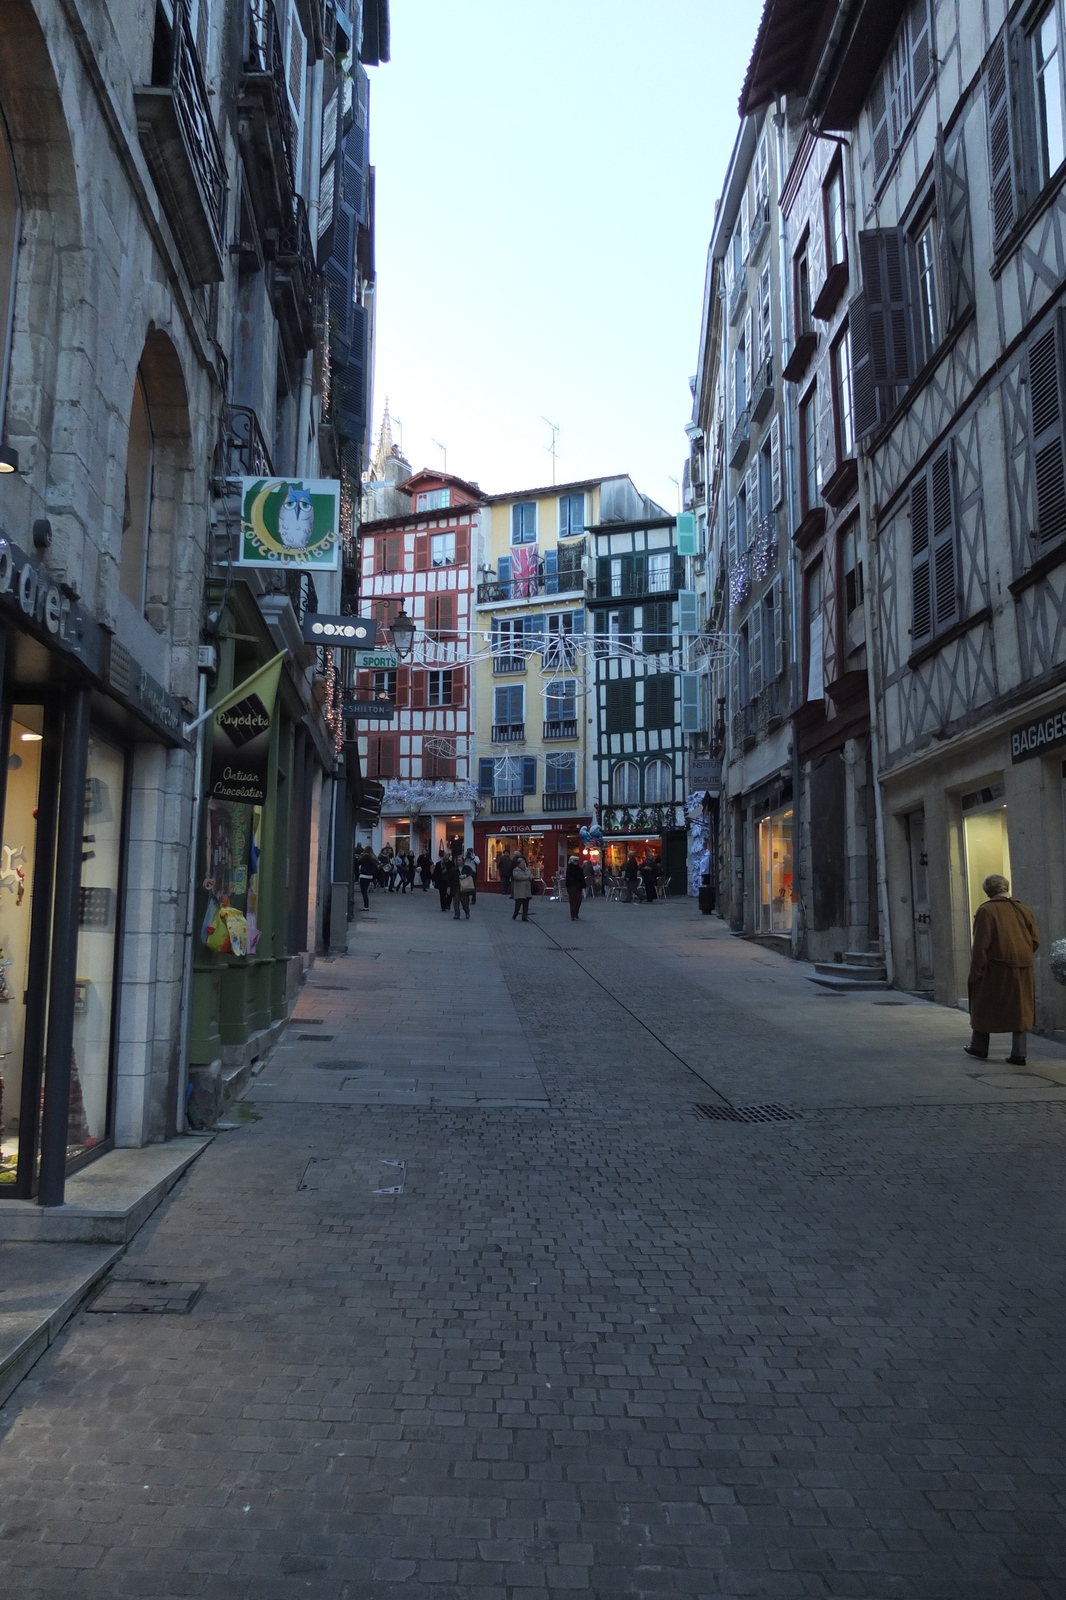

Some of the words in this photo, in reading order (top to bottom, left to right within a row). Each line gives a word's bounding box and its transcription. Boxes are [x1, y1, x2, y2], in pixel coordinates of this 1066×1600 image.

[362, 656, 397, 667] SPORTS
[218, 713, 270, 728] Puyodeba
[1012, 711, 1066, 756] BAGAGES
[223, 766, 259, 782] Artisan
[213, 781, 264, 798] Chocolatier
